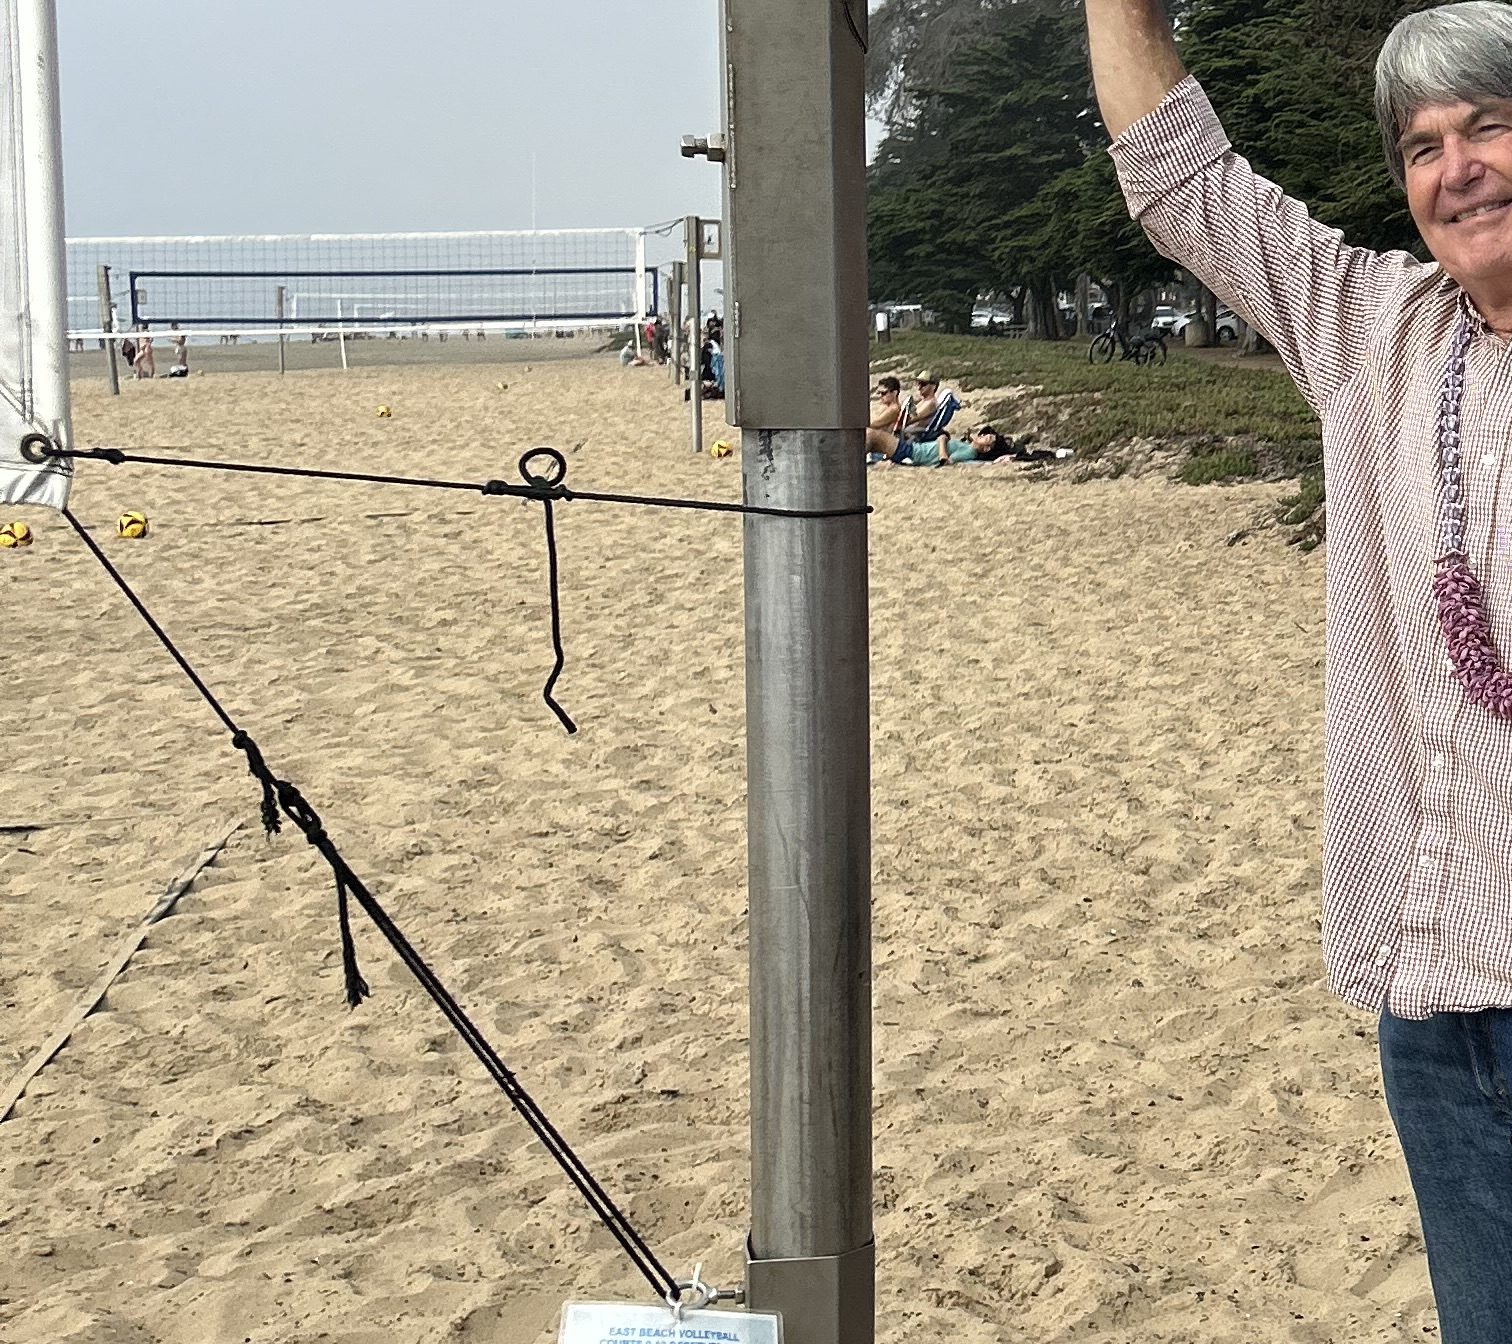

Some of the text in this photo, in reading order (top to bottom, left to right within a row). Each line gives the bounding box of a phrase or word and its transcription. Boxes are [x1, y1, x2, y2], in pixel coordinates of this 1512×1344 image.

[608, 1327, 740, 1342] EAST BEACH VOLLEYBALL
